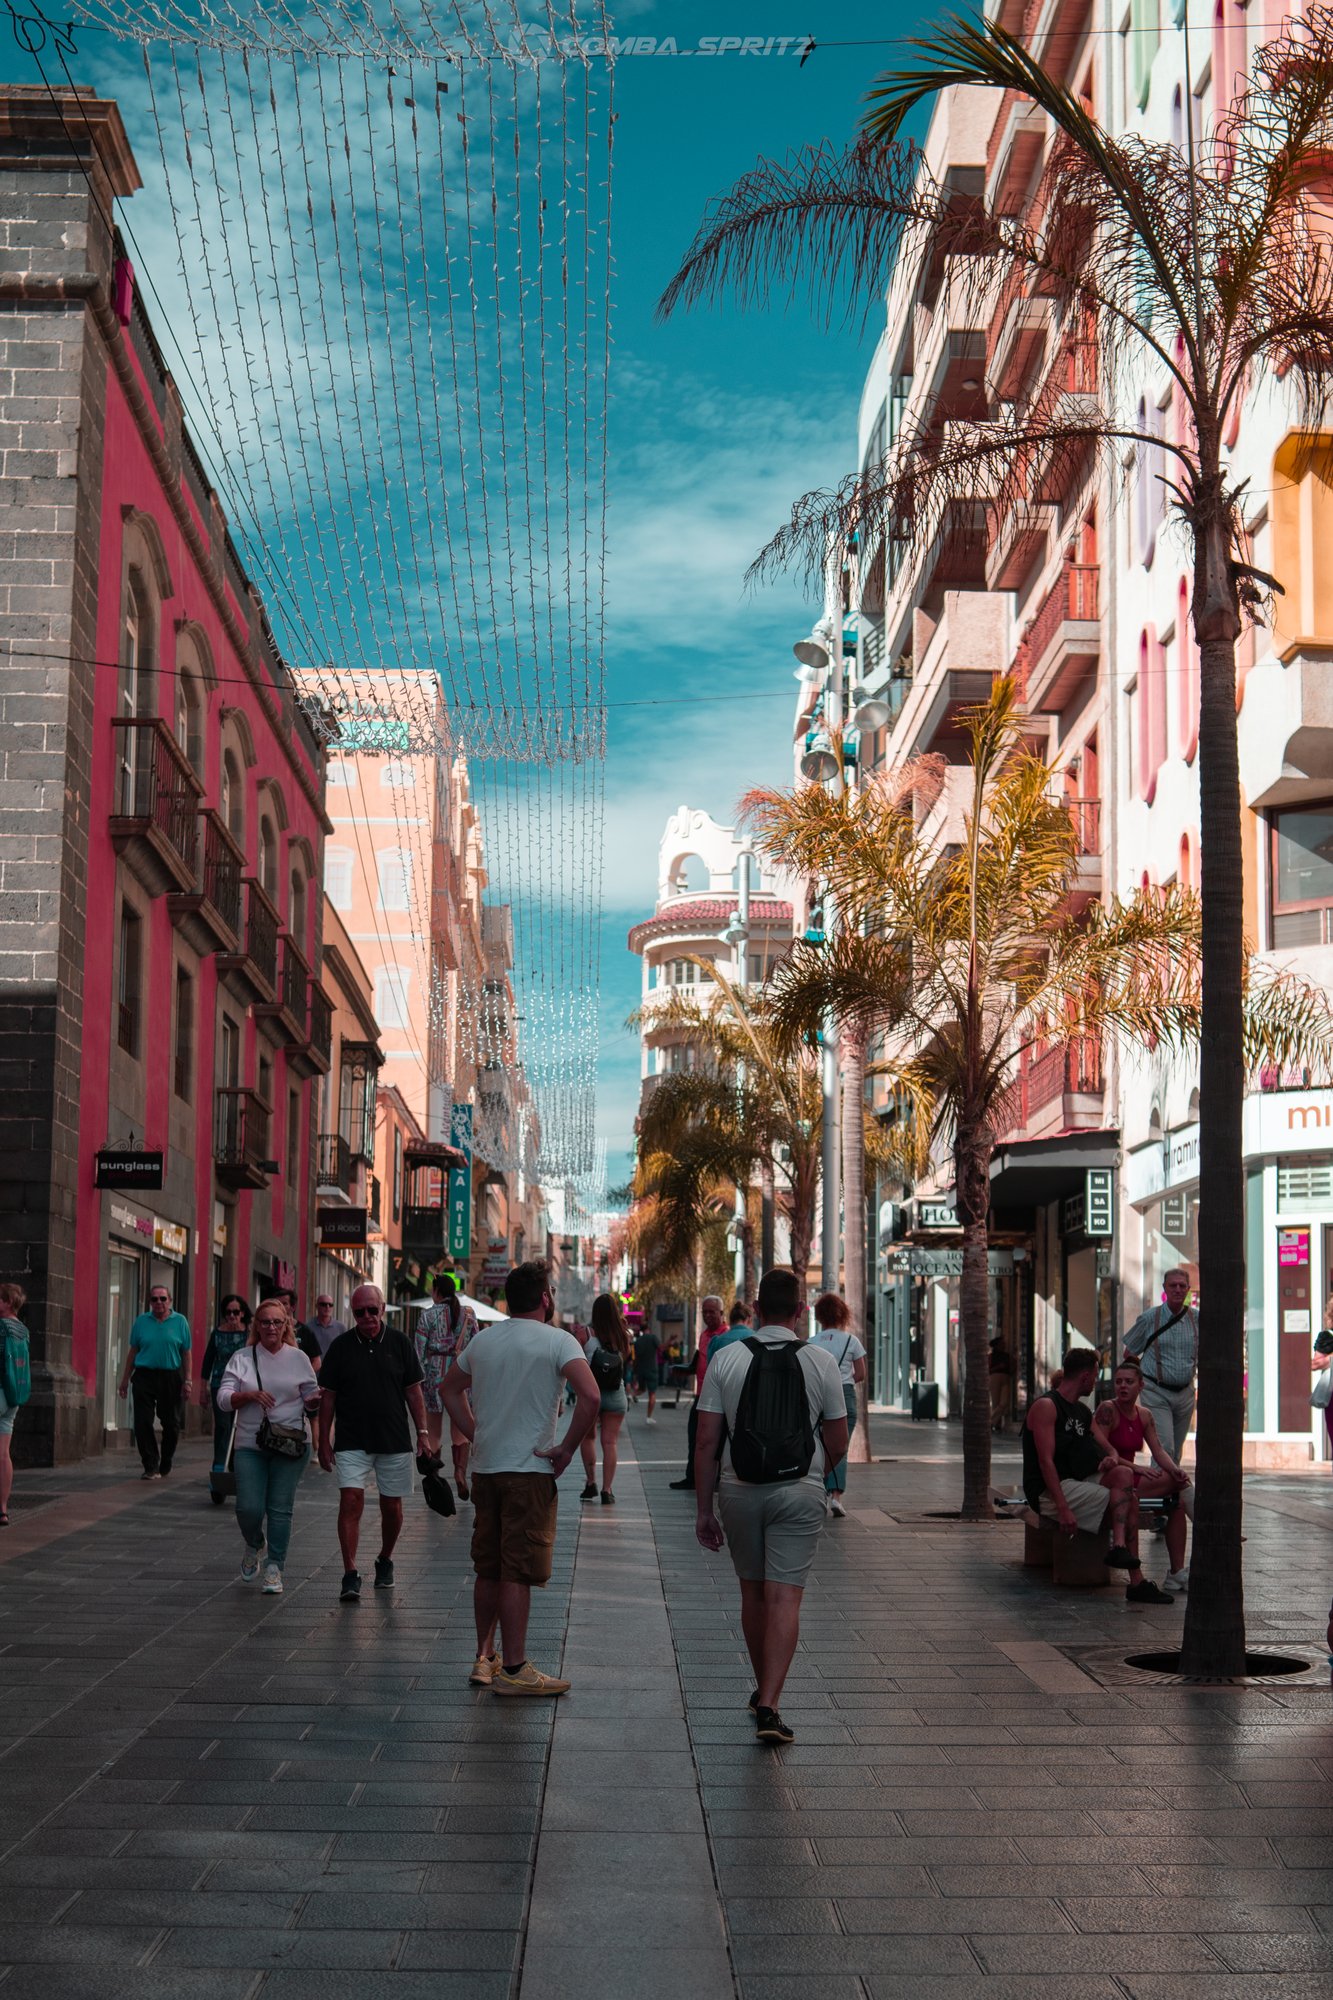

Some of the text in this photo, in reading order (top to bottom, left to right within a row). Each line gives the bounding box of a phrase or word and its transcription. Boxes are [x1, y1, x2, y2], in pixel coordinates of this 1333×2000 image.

[100, 1161, 160, 1172] sunglass
[1094, 1177, 1105, 1185] MI
[1093, 1198, 1105, 1206] SA
[454, 1200, 465, 1249] RIEU
[1093, 1218, 1106, 1226] KO
